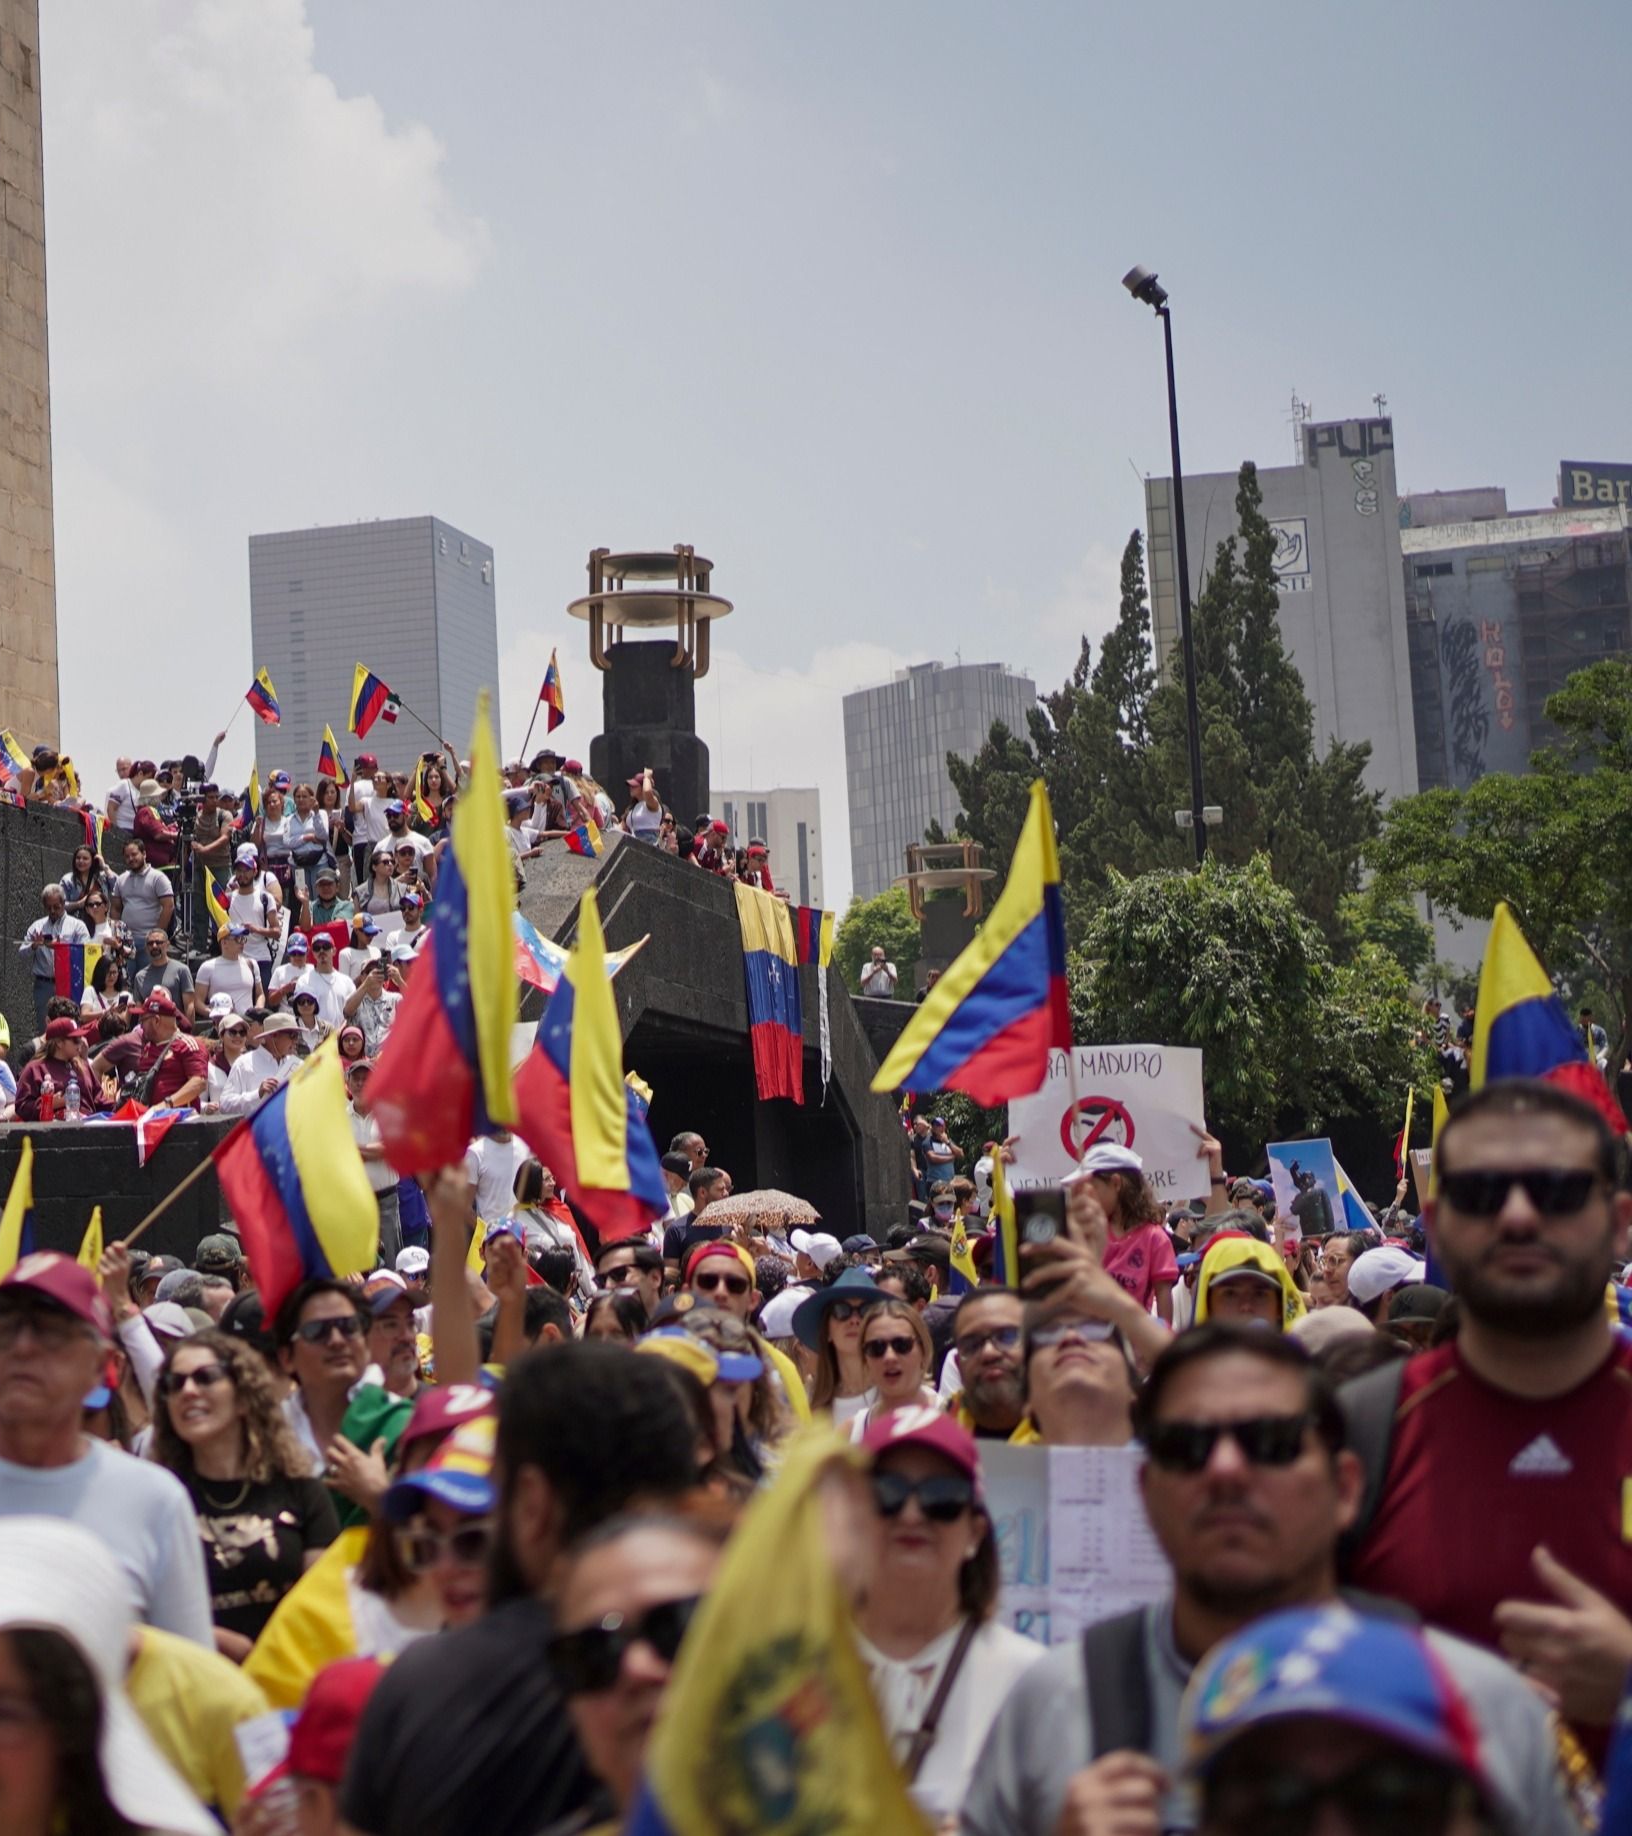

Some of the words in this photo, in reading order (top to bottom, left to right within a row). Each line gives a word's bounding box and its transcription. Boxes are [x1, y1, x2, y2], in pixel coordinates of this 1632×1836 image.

[1571, 469, 1632, 502] Bar
[1273, 576, 1312, 592] STE
[1080, 1051, 1162, 1079] MADURO
